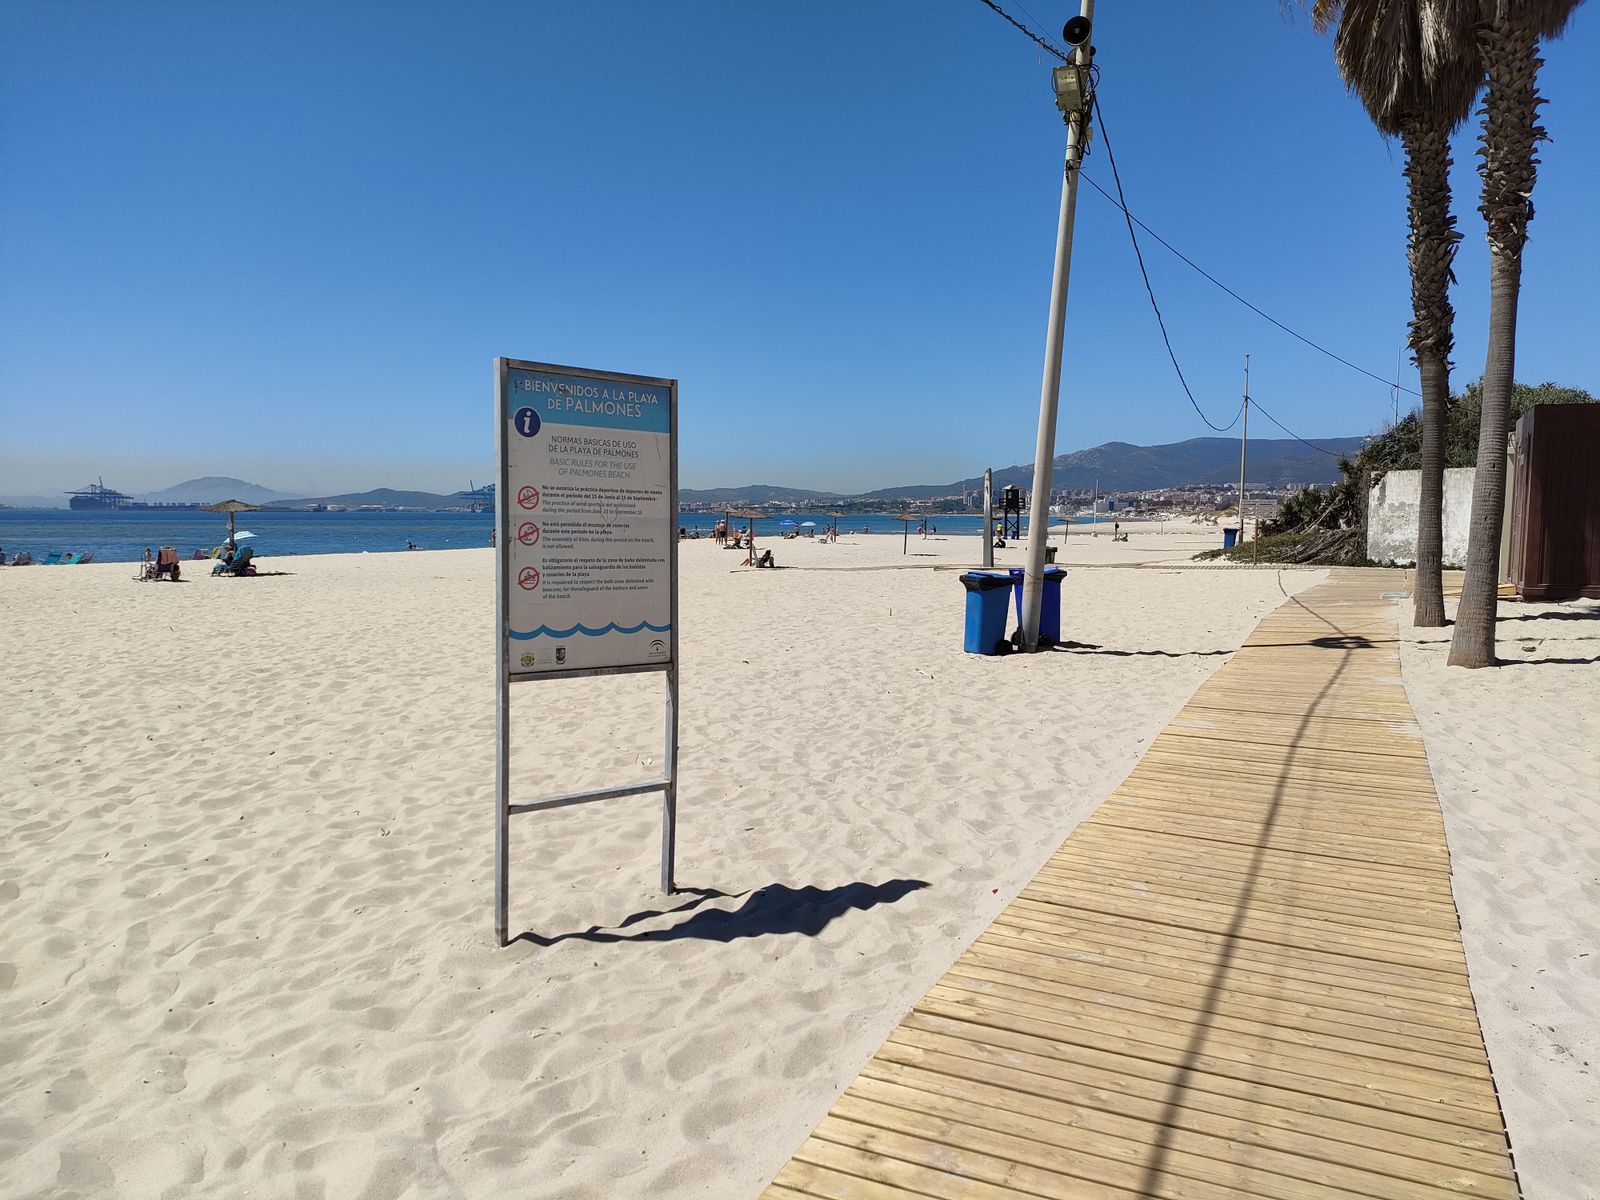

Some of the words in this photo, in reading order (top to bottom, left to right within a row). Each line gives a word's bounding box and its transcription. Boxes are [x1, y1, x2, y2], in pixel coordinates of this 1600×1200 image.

[525, 380, 598, 398] BIENVENIDOS
[602, 390, 610, 398] A
[613, 390, 625, 401] LA
[629, 392, 658, 404] PLAYA
[548, 398, 561, 410] DE
[566, 397, 641, 418] PALMONES
[552, 436, 582, 445] NORMAS
[584, 438, 610, 447] BASICAS
[613, 440, 621, 448] DE
[623, 440, 637, 449] USO
[570, 446, 591, 455] PLAYA
[593, 447, 601, 455] DE
[603, 448, 639, 458] PALMONES
[550, 458, 570, 466] BASIC
[572, 459, 592, 467] RULES
[594, 460, 607, 468] FOR
[610, 461, 623, 469] THE
[624, 462, 636, 470] USE
[570, 468, 606, 478] PALMONES
[608, 470, 630, 479] BEACH
